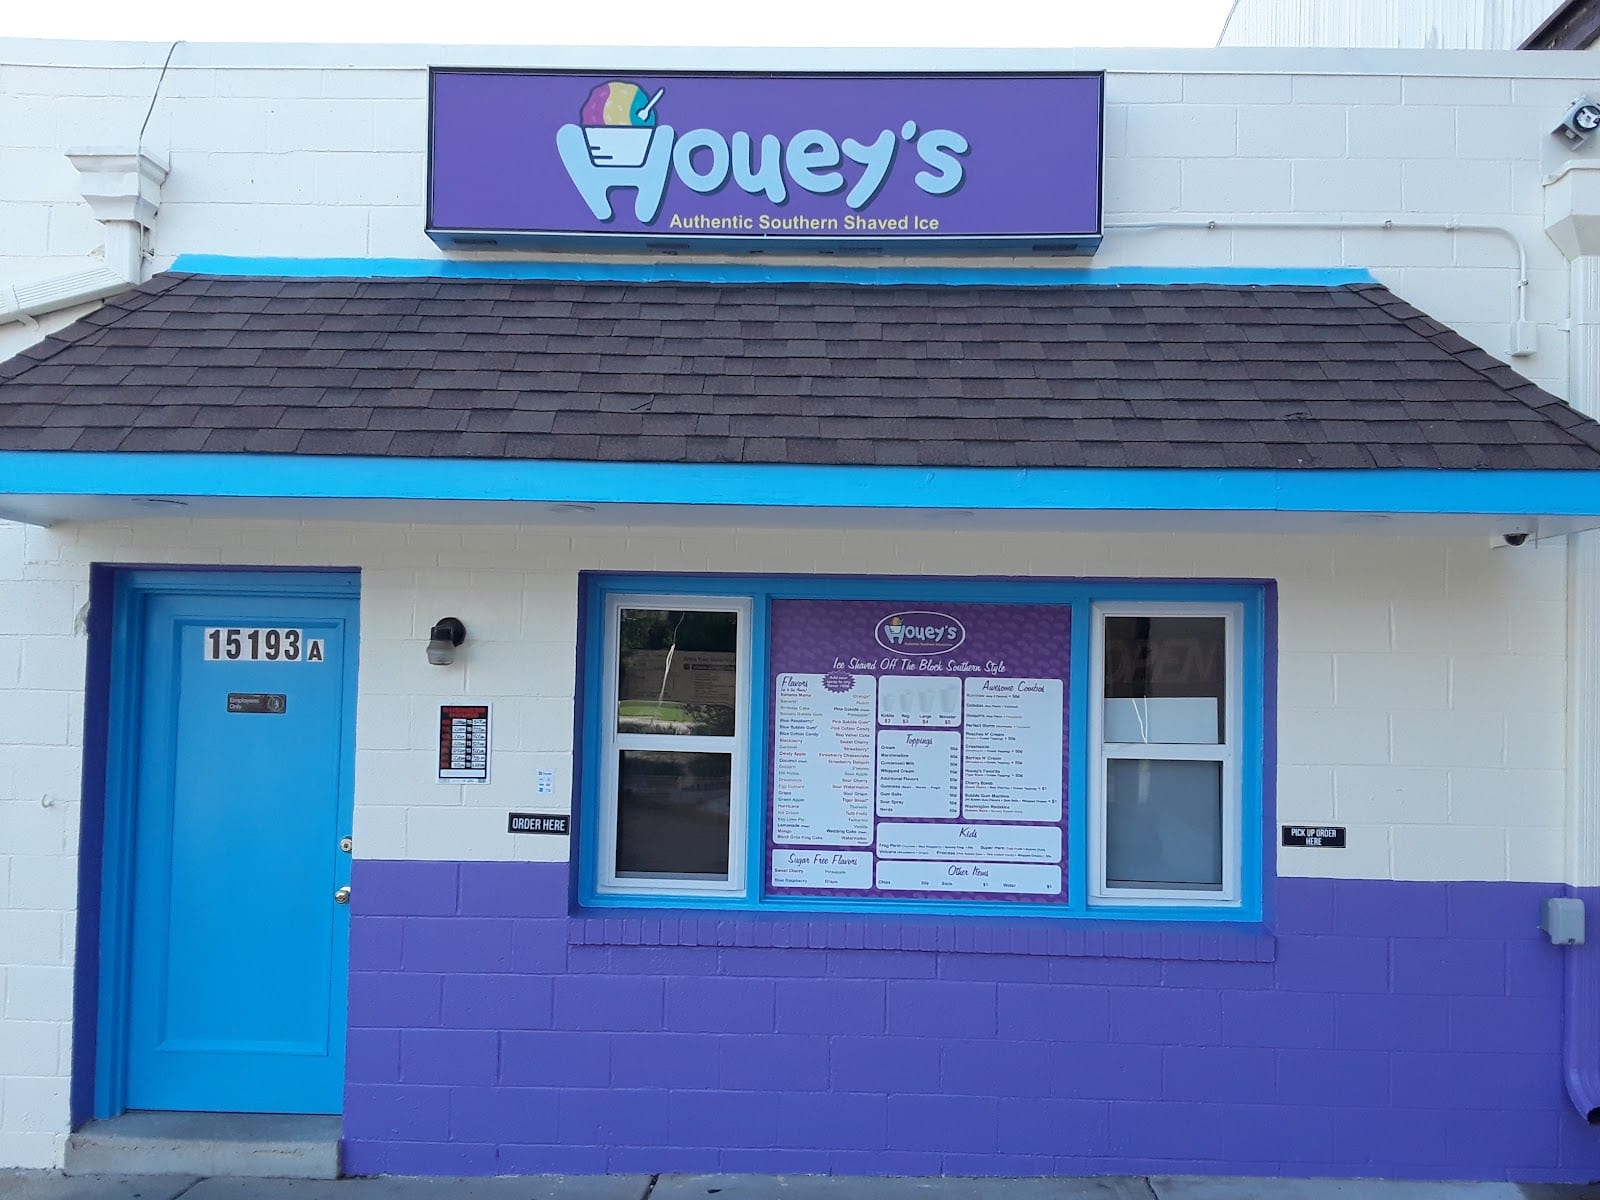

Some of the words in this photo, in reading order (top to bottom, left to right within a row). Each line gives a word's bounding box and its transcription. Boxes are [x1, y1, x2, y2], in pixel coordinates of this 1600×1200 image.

[555, 120, 969, 222] Houey's
[669, 214, 754, 229] Authentic
[759, 215, 838, 230] Southern
[844, 216, 909, 230] Shaved
[914, 217, 940, 230] Ice
[884, 623, 958, 645] Houey's
[208, 629, 300, 660] 15193
[308, 640, 323, 661] A
[833, 657, 845, 669] Ice
[848, 658, 876, 670] Shaved
[880, 658, 896, 670] Off
[901, 659, 915, 671] The
[919, 659, 943, 672] Block
[946, 660, 981, 672] Southern
[984, 661, 1006, 675] Style
[781, 676, 808, 687] Flavors
[906, 734, 933, 747] Toppings
[512, 817, 541, 830] ORDER
[543, 818, 566, 831] HERE
[959, 827, 978, 839] Kids
[1291, 828, 1306, 837] PICK
[1307, 829, 1315, 837] UP
[1316, 829, 1337, 838] ORDER
[1305, 837, 1323, 846] HERE
[788, 852, 810, 867] Sugar
[813, 853, 829, 865] Free
[831, 854, 858, 866] Flavors
